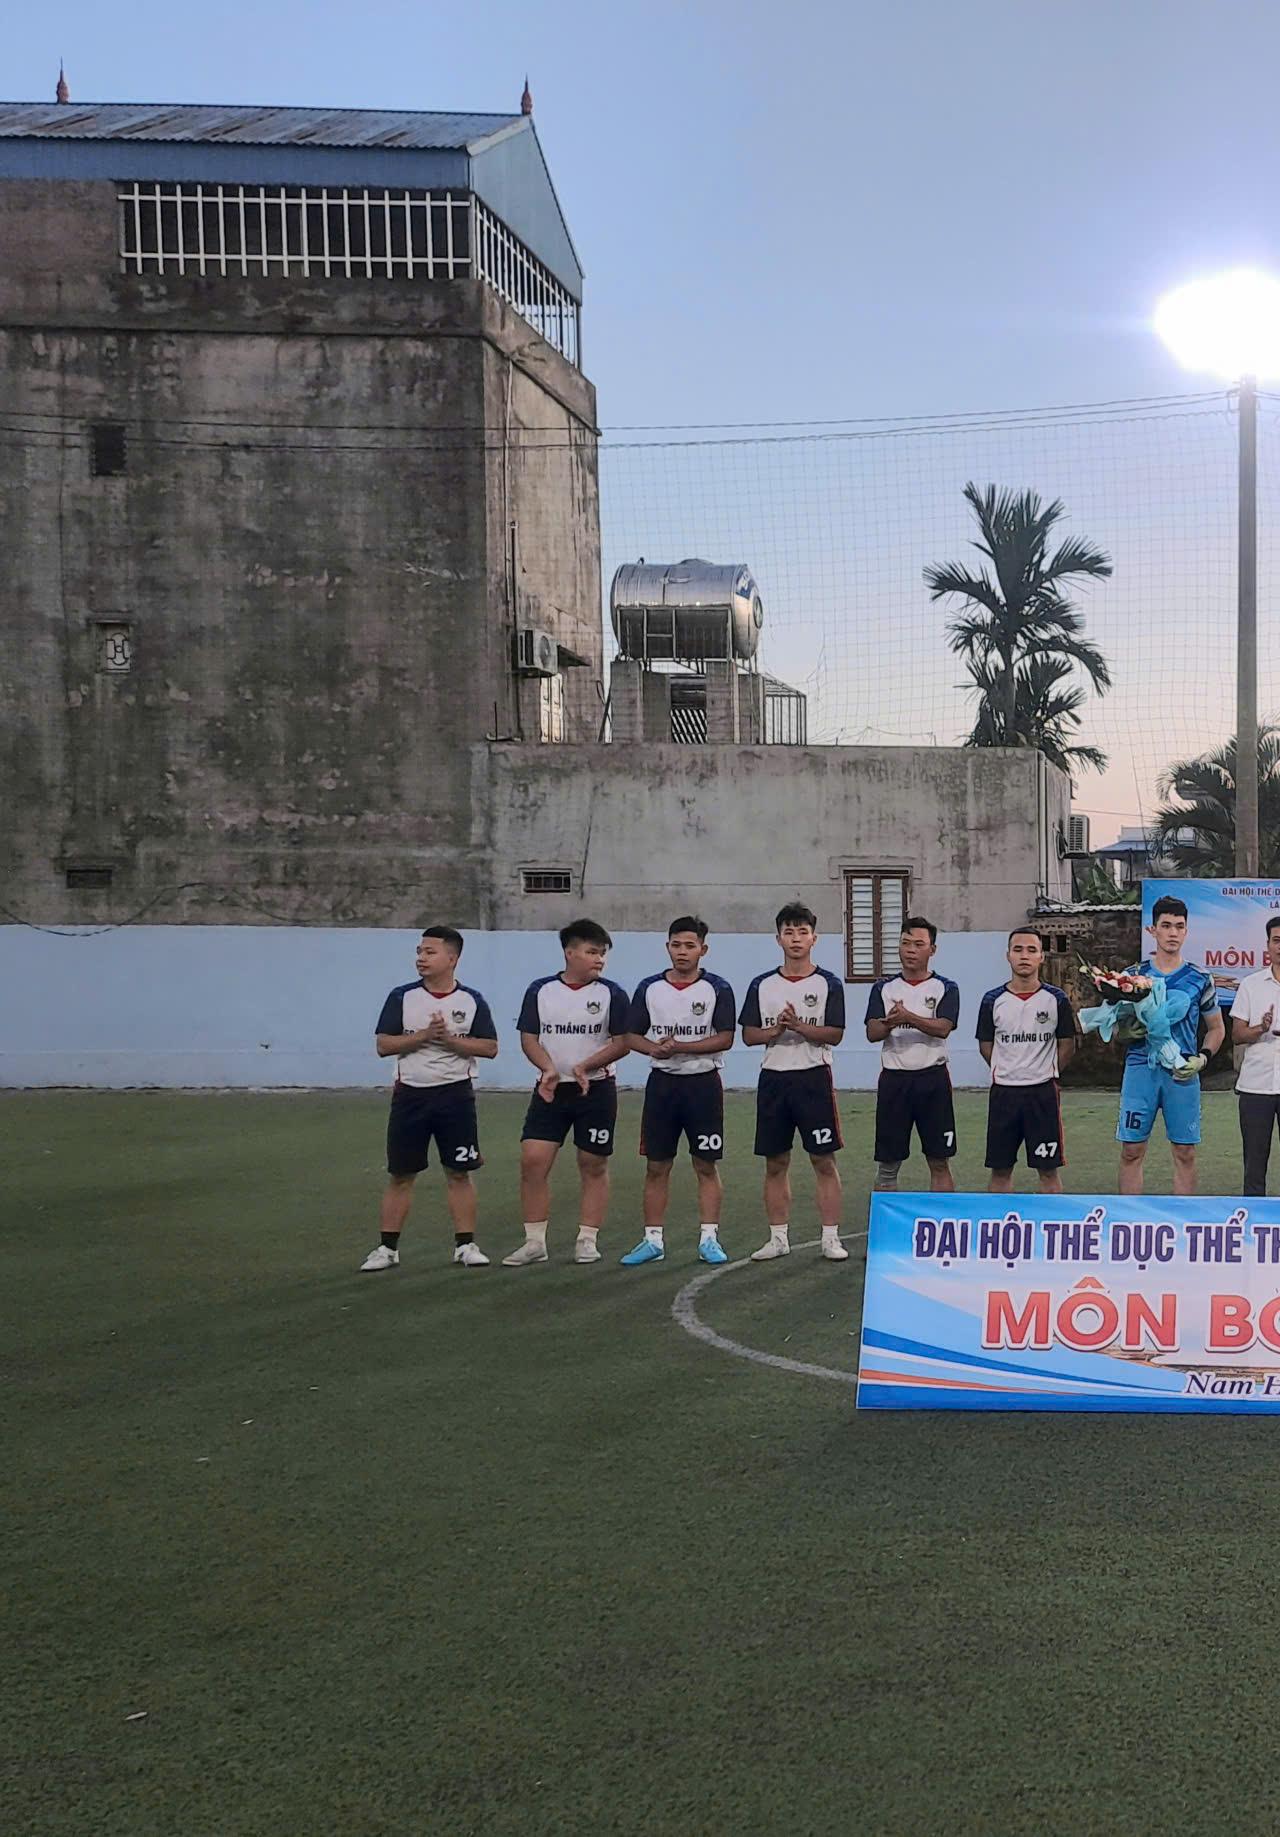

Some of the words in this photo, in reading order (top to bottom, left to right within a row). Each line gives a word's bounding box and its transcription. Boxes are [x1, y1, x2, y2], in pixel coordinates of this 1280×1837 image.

[1205, 946, 1254, 967] MÔN
[555, 1021, 586, 1034] THẮNG
[652, 1025, 662, 1035] FC
[765, 1017, 775, 1026] FC
[1125, 1110, 1142, 1130] 16
[588, 1128, 610, 1144] 19
[698, 1134, 722, 1150] 20
[812, 1128, 832, 1145] 12
[943, 1131, 954, 1148] 7
[455, 1145, 478, 1162] 24
[1034, 1142, 1058, 1158] 47
[914, 1219, 969, 1267] ĐẠI
[978, 1212, 1033, 1273] HỘI
[1044, 1207, 1105, 1262] THỂ
[1111, 1223, 1174, 1271] DỤC
[1185, 1209, 1247, 1264] THỂ
[985, 1276, 1177, 1349] MÔN
[1185, 1374, 1254, 1397] Nam
